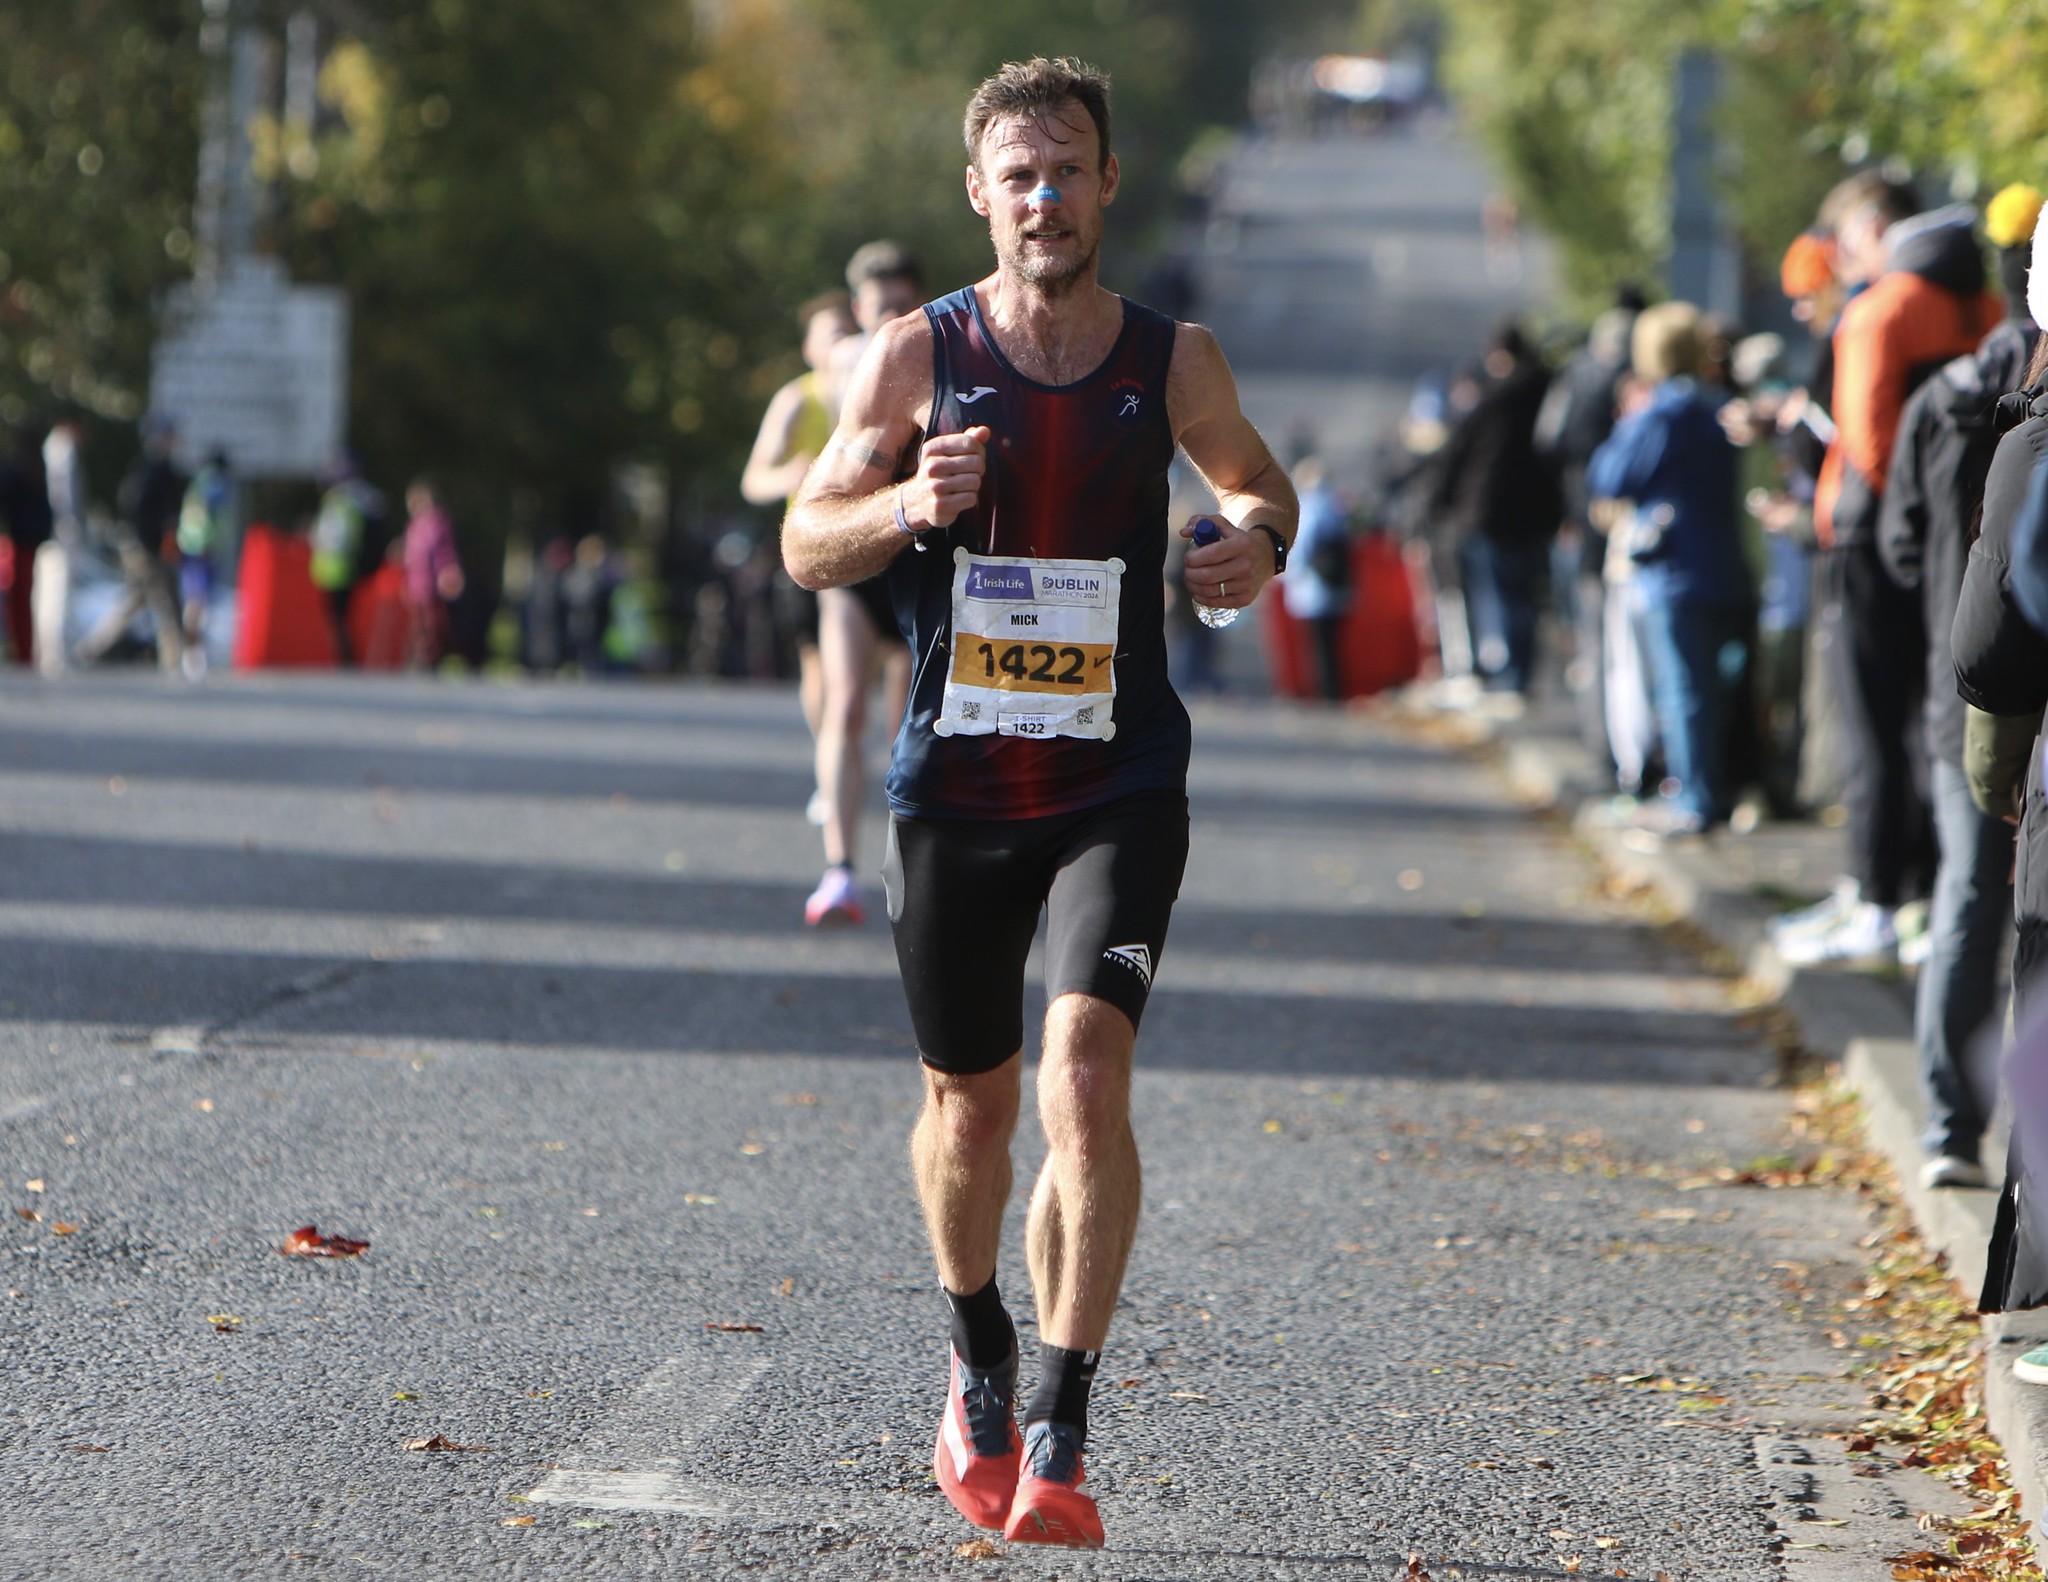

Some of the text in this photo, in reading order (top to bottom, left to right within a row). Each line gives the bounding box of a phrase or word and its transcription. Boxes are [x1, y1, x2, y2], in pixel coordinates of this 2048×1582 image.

[983, 578, 1025, 590] Irish Life
[1042, 576, 1099, 591] DUBLIN
[1041, 591, 1082, 600] MARATHON
[1010, 614, 1039, 626] MICK
[978, 643, 1085, 685] 1422
[1013, 723, 1045, 734] 1422
[1103, 951, 1133, 970] NIKE
